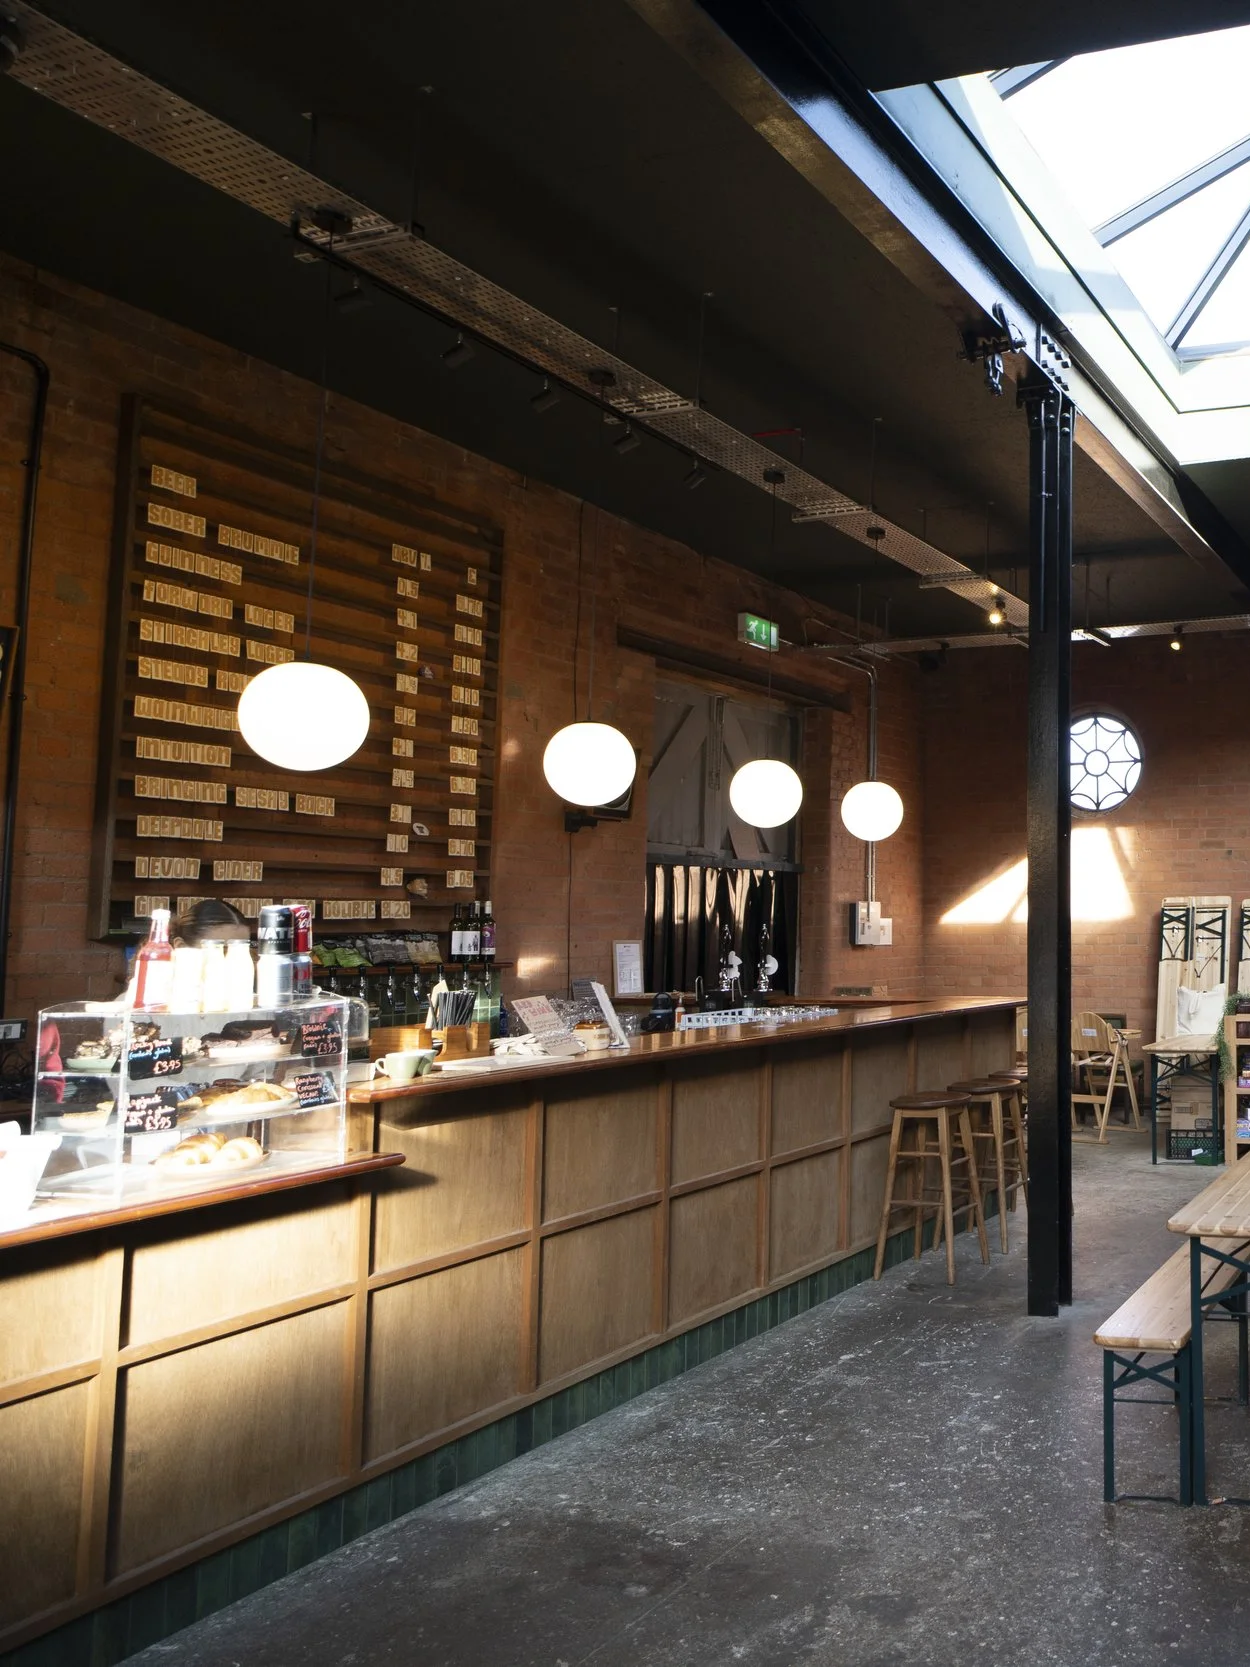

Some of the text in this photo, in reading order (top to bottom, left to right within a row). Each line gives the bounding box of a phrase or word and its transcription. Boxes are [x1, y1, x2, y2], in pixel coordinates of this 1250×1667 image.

[153, 466, 195, 497] BEER
[149, 504, 205, 537] SOBER
[219, 525, 298, 564] BRUMMIE
[147, 542, 241, 585] GUINNESS
[145, 581, 232, 618] FORWARD
[245, 605, 293, 632] LAGER
[396, 642, 418, 662] 4.2
[141, 620, 239, 655] STIRCHLEY
[247, 641, 294, 663] LAGER
[139, 657, 207, 687] STEADY
[137, 737, 230, 766] INTUITION
[136, 776, 227, 803] BRINGING
[296, 795, 334, 816] BACK
[137, 816, 222, 840] DEEPDALE
[136, 857, 473, 888] DEVON CIDER 4.5 6.05
[323, 901, 375, 919] DOUBLE
[382, 902, 410, 918] 8.20
[153, 1060, 181, 1074] £3.95
[145, 1116, 171, 1130] £3.95
